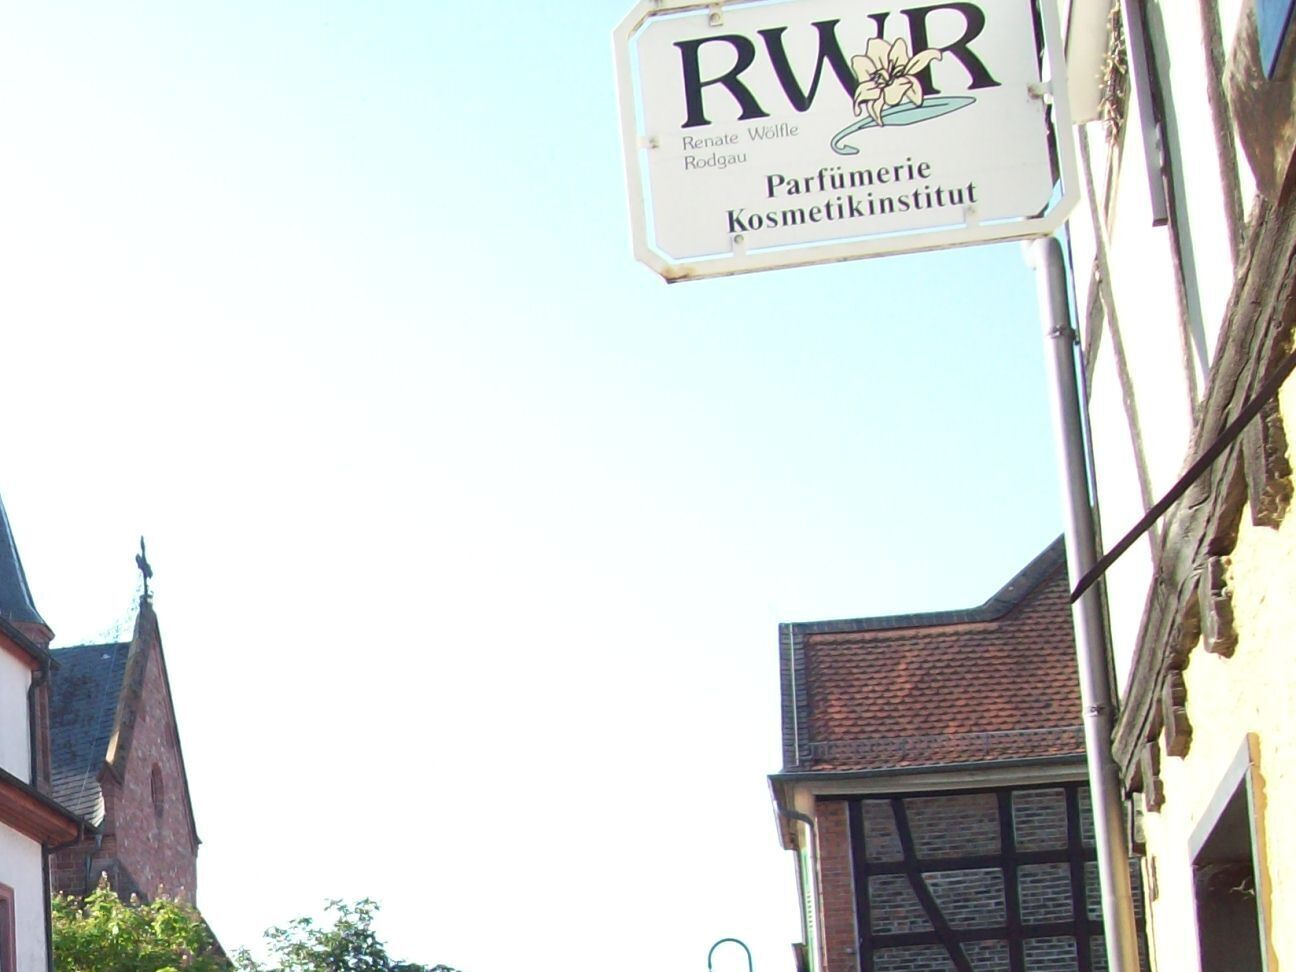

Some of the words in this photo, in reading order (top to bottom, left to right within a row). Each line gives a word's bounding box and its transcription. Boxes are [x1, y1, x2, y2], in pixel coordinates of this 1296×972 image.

[673, 2, 1002, 128] RWR
[682, 133, 739, 151] Renate
[747, 122, 800, 142] Wölfle
[684, 152, 747, 170] Rodgau
[765, 157, 932, 198] Parfümerie
[727, 181, 977, 233] Kosmetikinstitut
